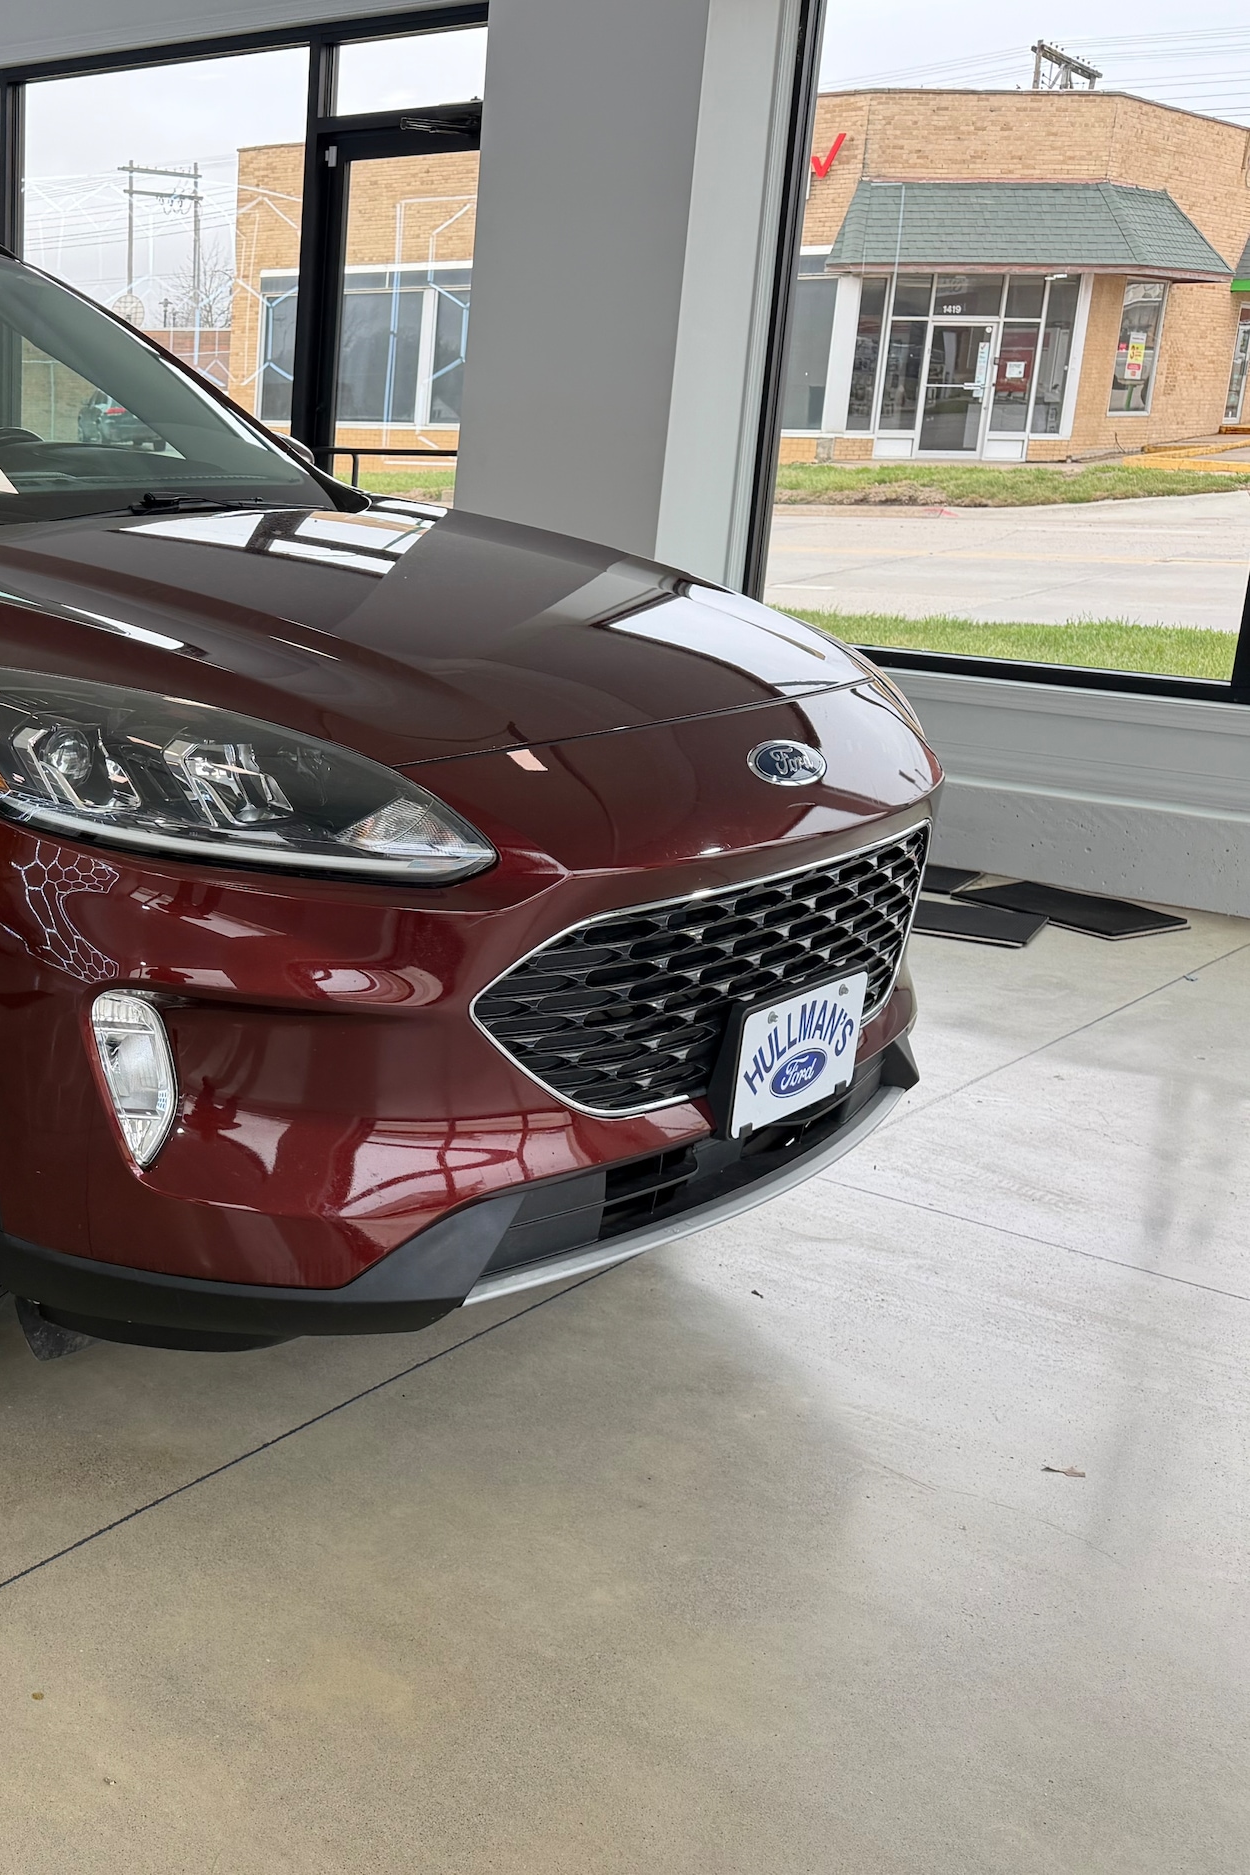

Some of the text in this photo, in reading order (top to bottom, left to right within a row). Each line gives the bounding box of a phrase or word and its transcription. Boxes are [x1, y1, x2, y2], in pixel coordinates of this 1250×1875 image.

[942, 304, 962, 314] 1419
[769, 746, 814, 775] Ford
[743, 999, 854, 1096] HULLMAN'S
[780, 1054, 815, 1091] Ford
